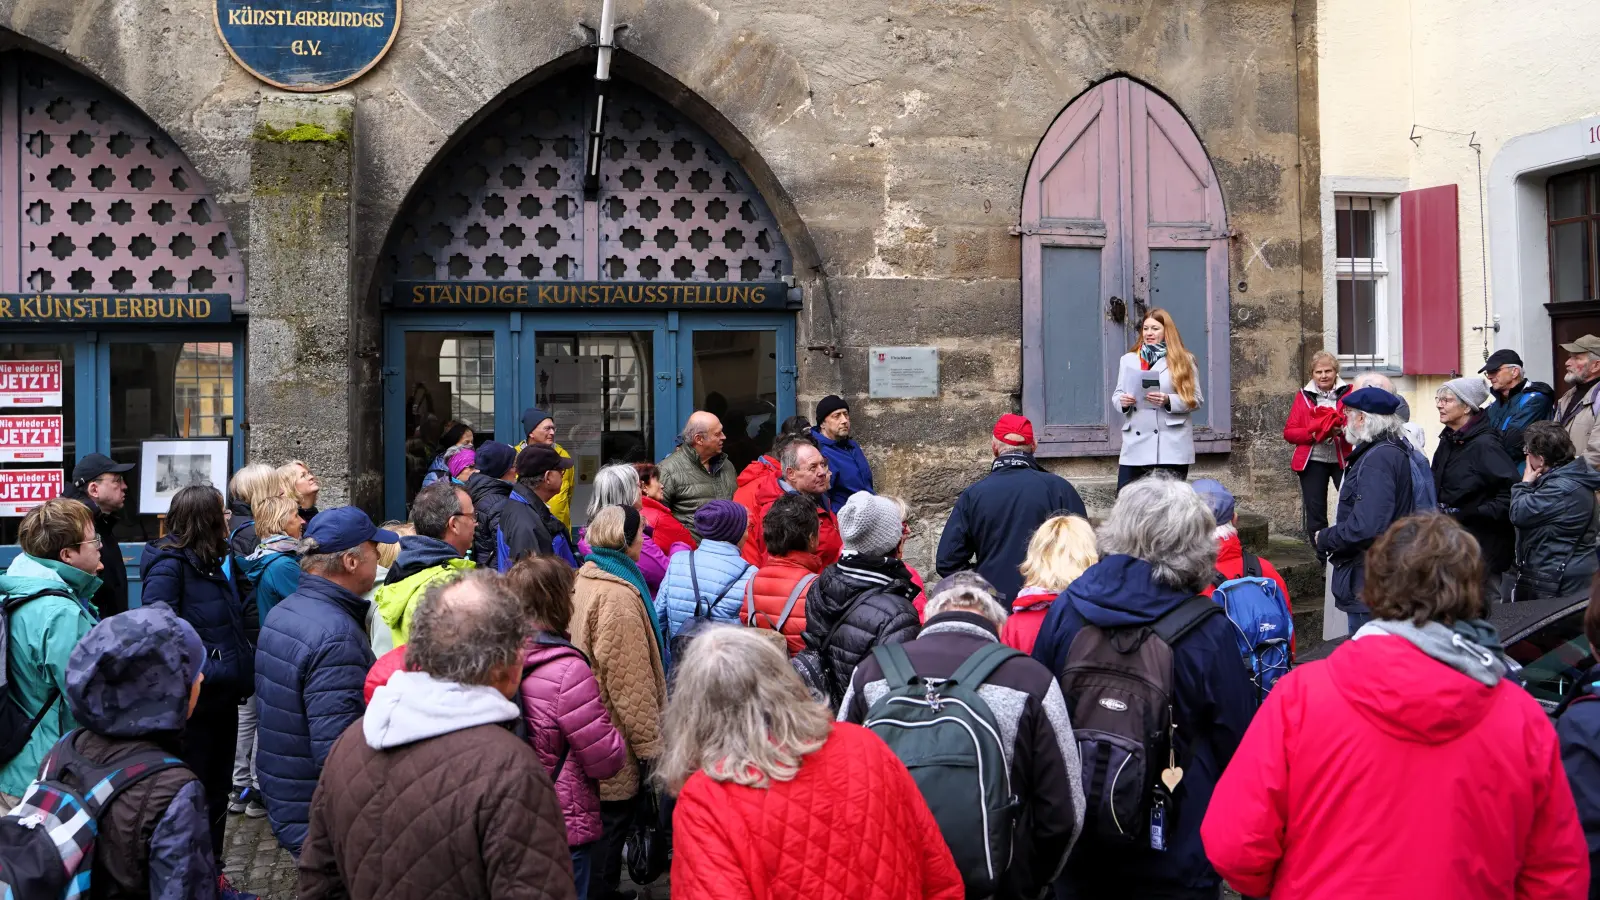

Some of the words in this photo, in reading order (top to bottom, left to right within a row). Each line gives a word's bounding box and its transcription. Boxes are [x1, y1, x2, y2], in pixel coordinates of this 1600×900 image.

[228, 6, 385, 28] KÜNSTLERBUNDES
[291, 39, 322, 56] E.V.
[412, 285, 529, 304] STÄNDIGE
[538, 285, 766, 304] KUNSTAUSSTELLUNG
[19, 295, 211, 318] KÜNSTLERBUND
[0, 364, 12, 373] Nie
[16, 364, 44, 373] wieder
[47, 363, 59, 372] ist
[0, 419, 13, 428] Nie
[16, 419, 45, 428] wieder
[47, 418, 60, 428] ist
[0, 474, 14, 482] Nie
[16, 473, 45, 482] wieder
[48, 473, 60, 482] ist
